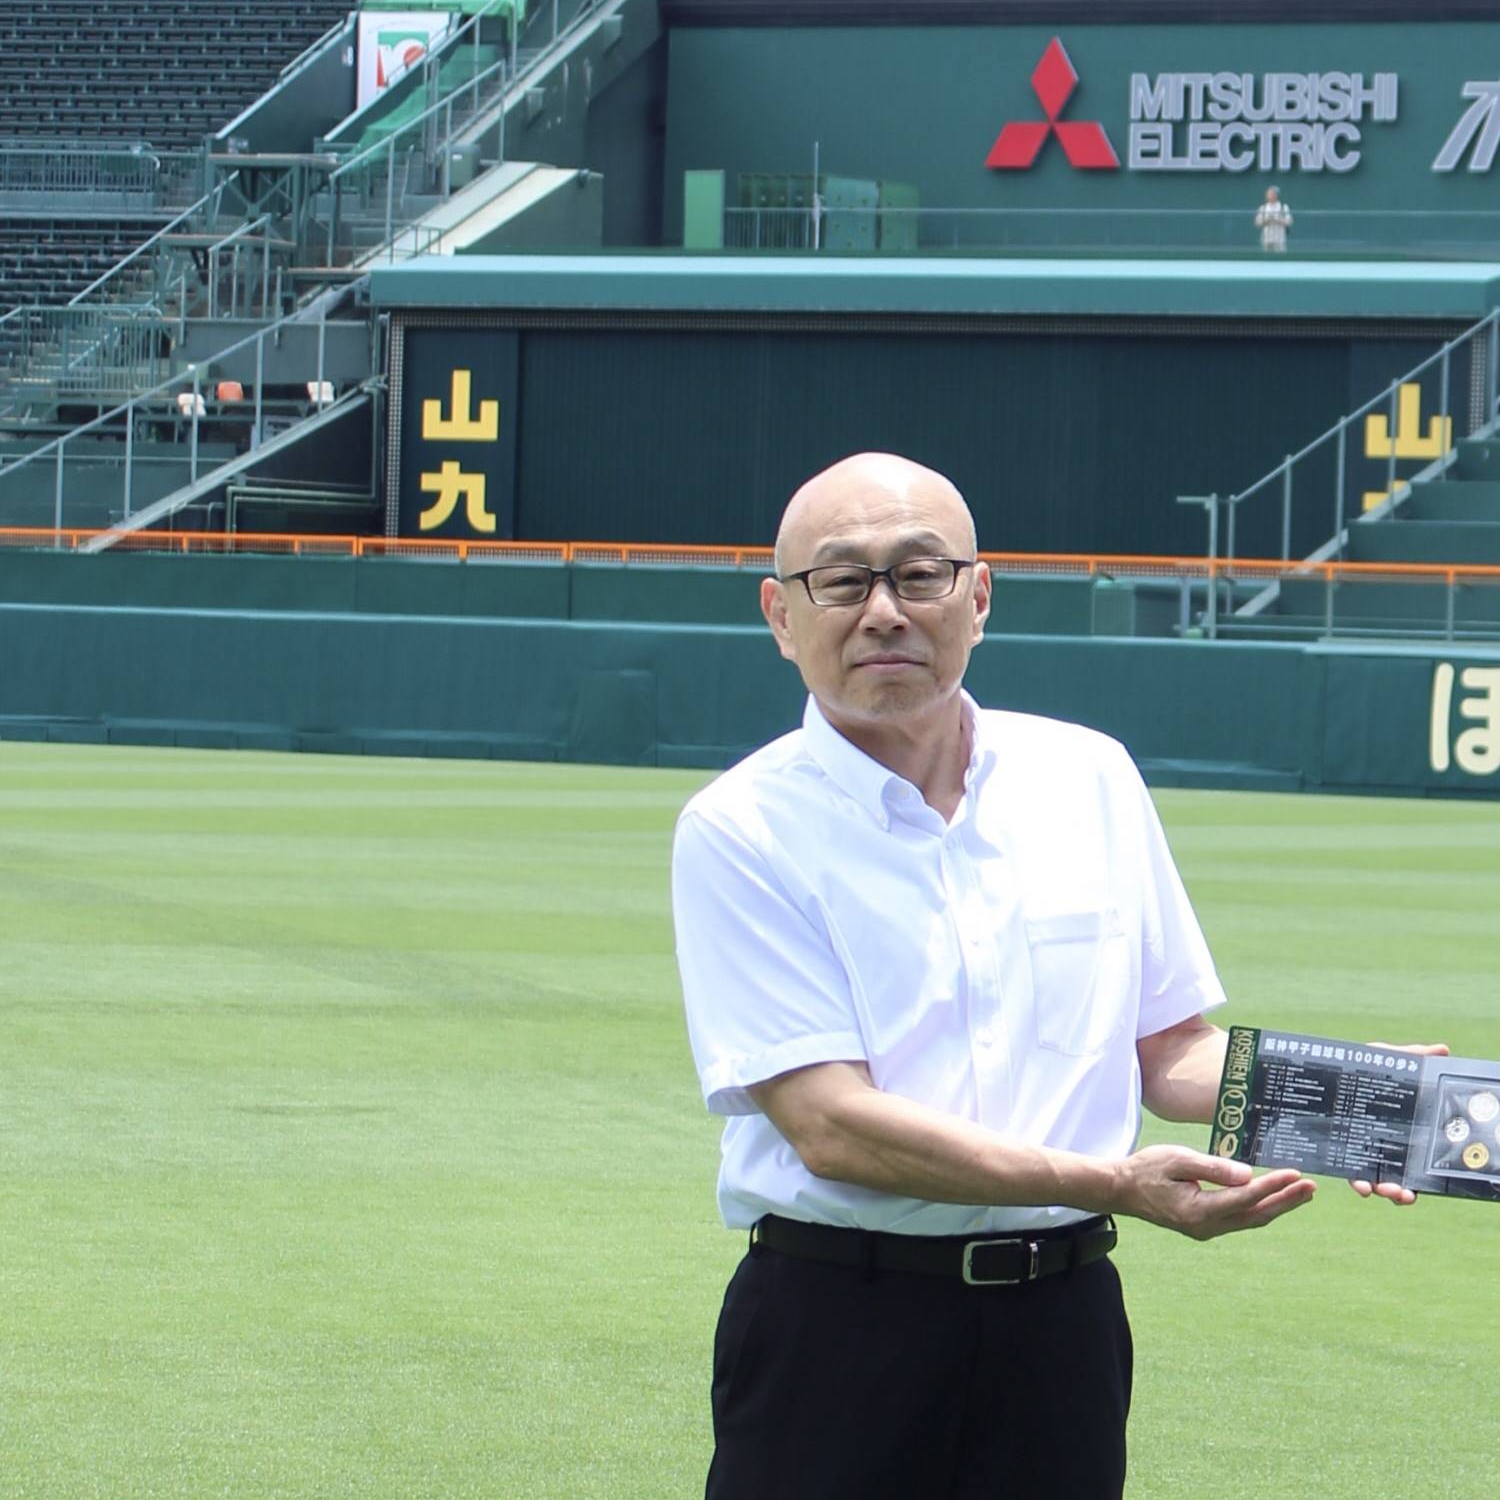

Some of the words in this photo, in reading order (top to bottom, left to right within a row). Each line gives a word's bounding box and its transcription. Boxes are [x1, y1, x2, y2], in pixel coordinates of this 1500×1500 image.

[1130, 72, 1397, 120] MITSUBISHI
[1128, 122, 1360, 171] ELECTRIC
[419, 369, 499, 533] 山九
[1362, 383, 1452, 512] 山
[1230, 1029, 1255, 1081] KOSHIEN
